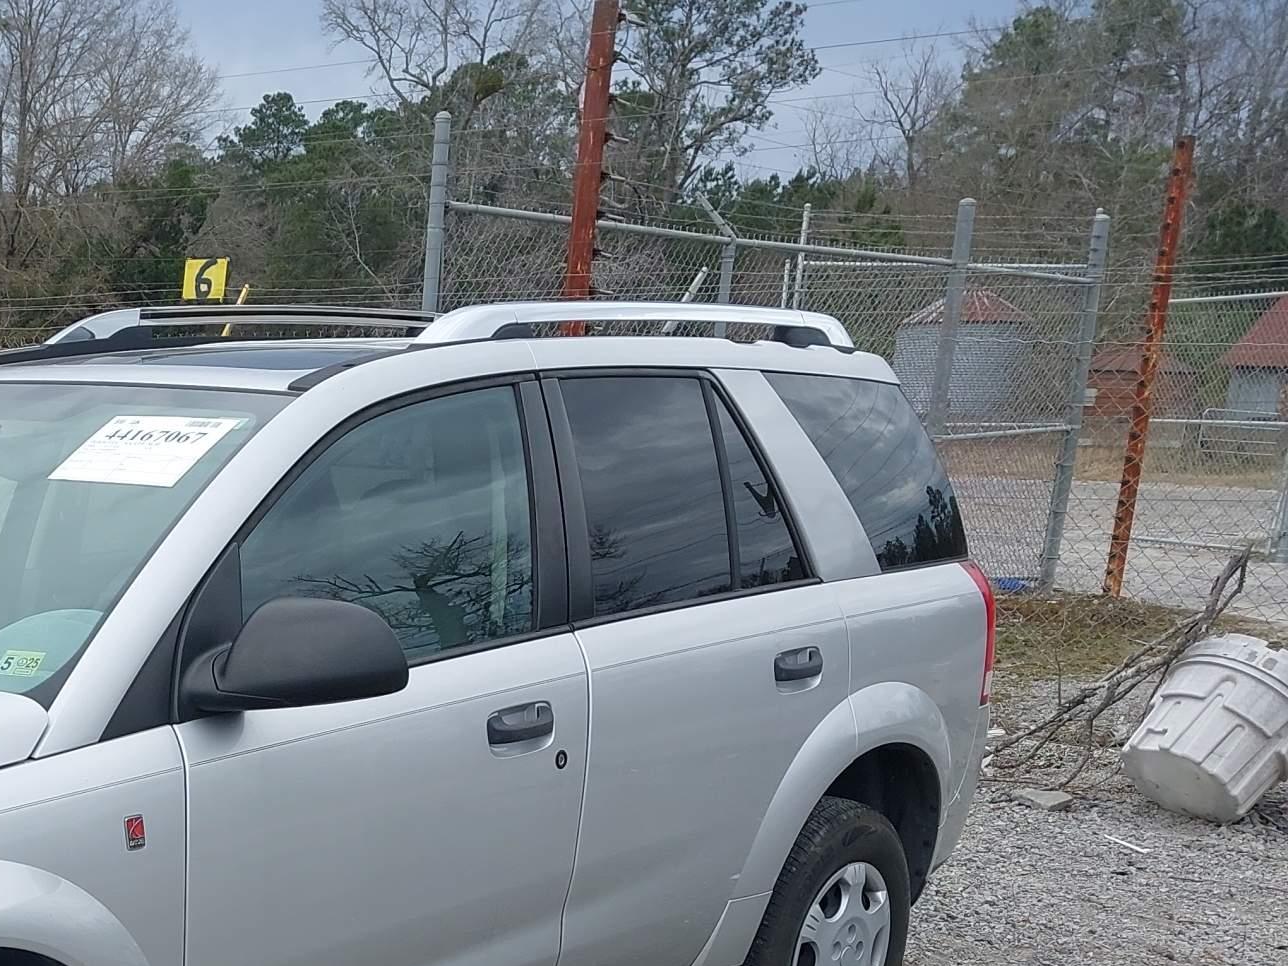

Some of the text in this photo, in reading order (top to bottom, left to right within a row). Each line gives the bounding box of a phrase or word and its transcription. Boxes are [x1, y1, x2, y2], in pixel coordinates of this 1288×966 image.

[195, 257, 218, 301] 6
[105, 429, 209, 445] 44167067
[0, 656, 41, 671] 5 25
